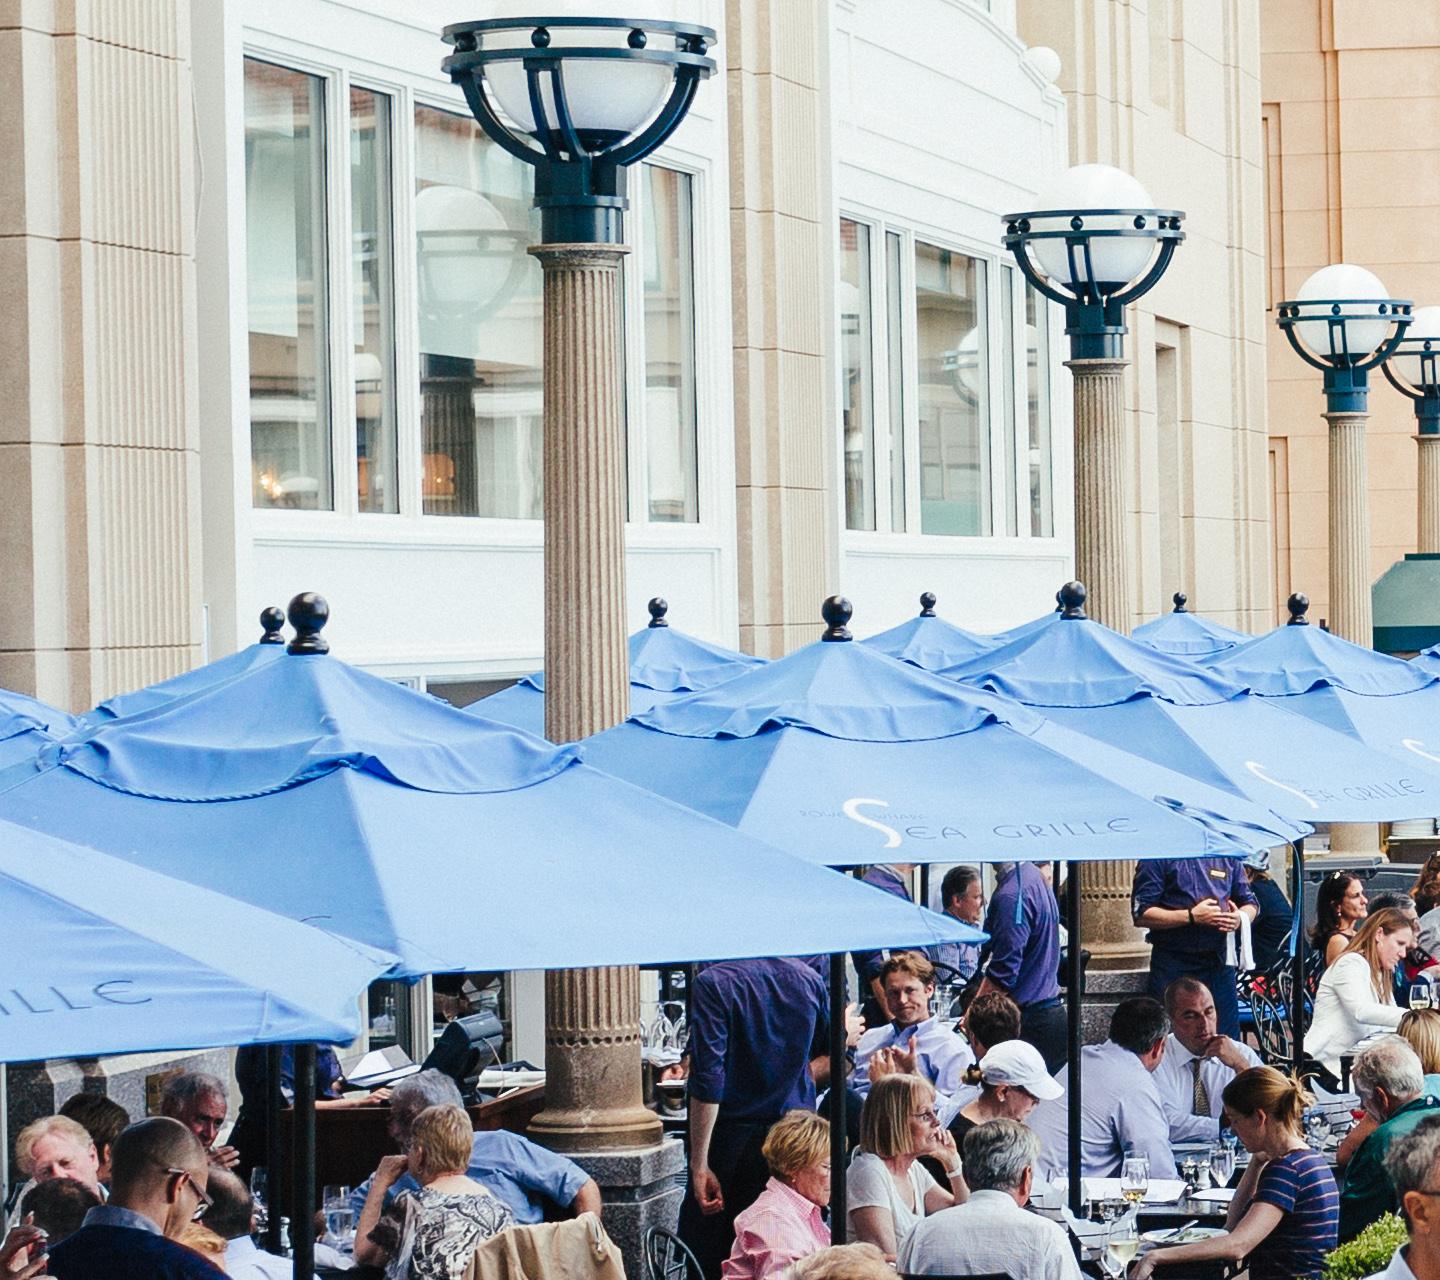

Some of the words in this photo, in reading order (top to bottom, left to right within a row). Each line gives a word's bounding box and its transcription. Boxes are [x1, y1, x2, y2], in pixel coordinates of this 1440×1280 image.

[1343, 778, 1425, 802] GRILLE
[842, 797, 968, 848] SEA
[993, 817, 1139, 839] GRILLE
